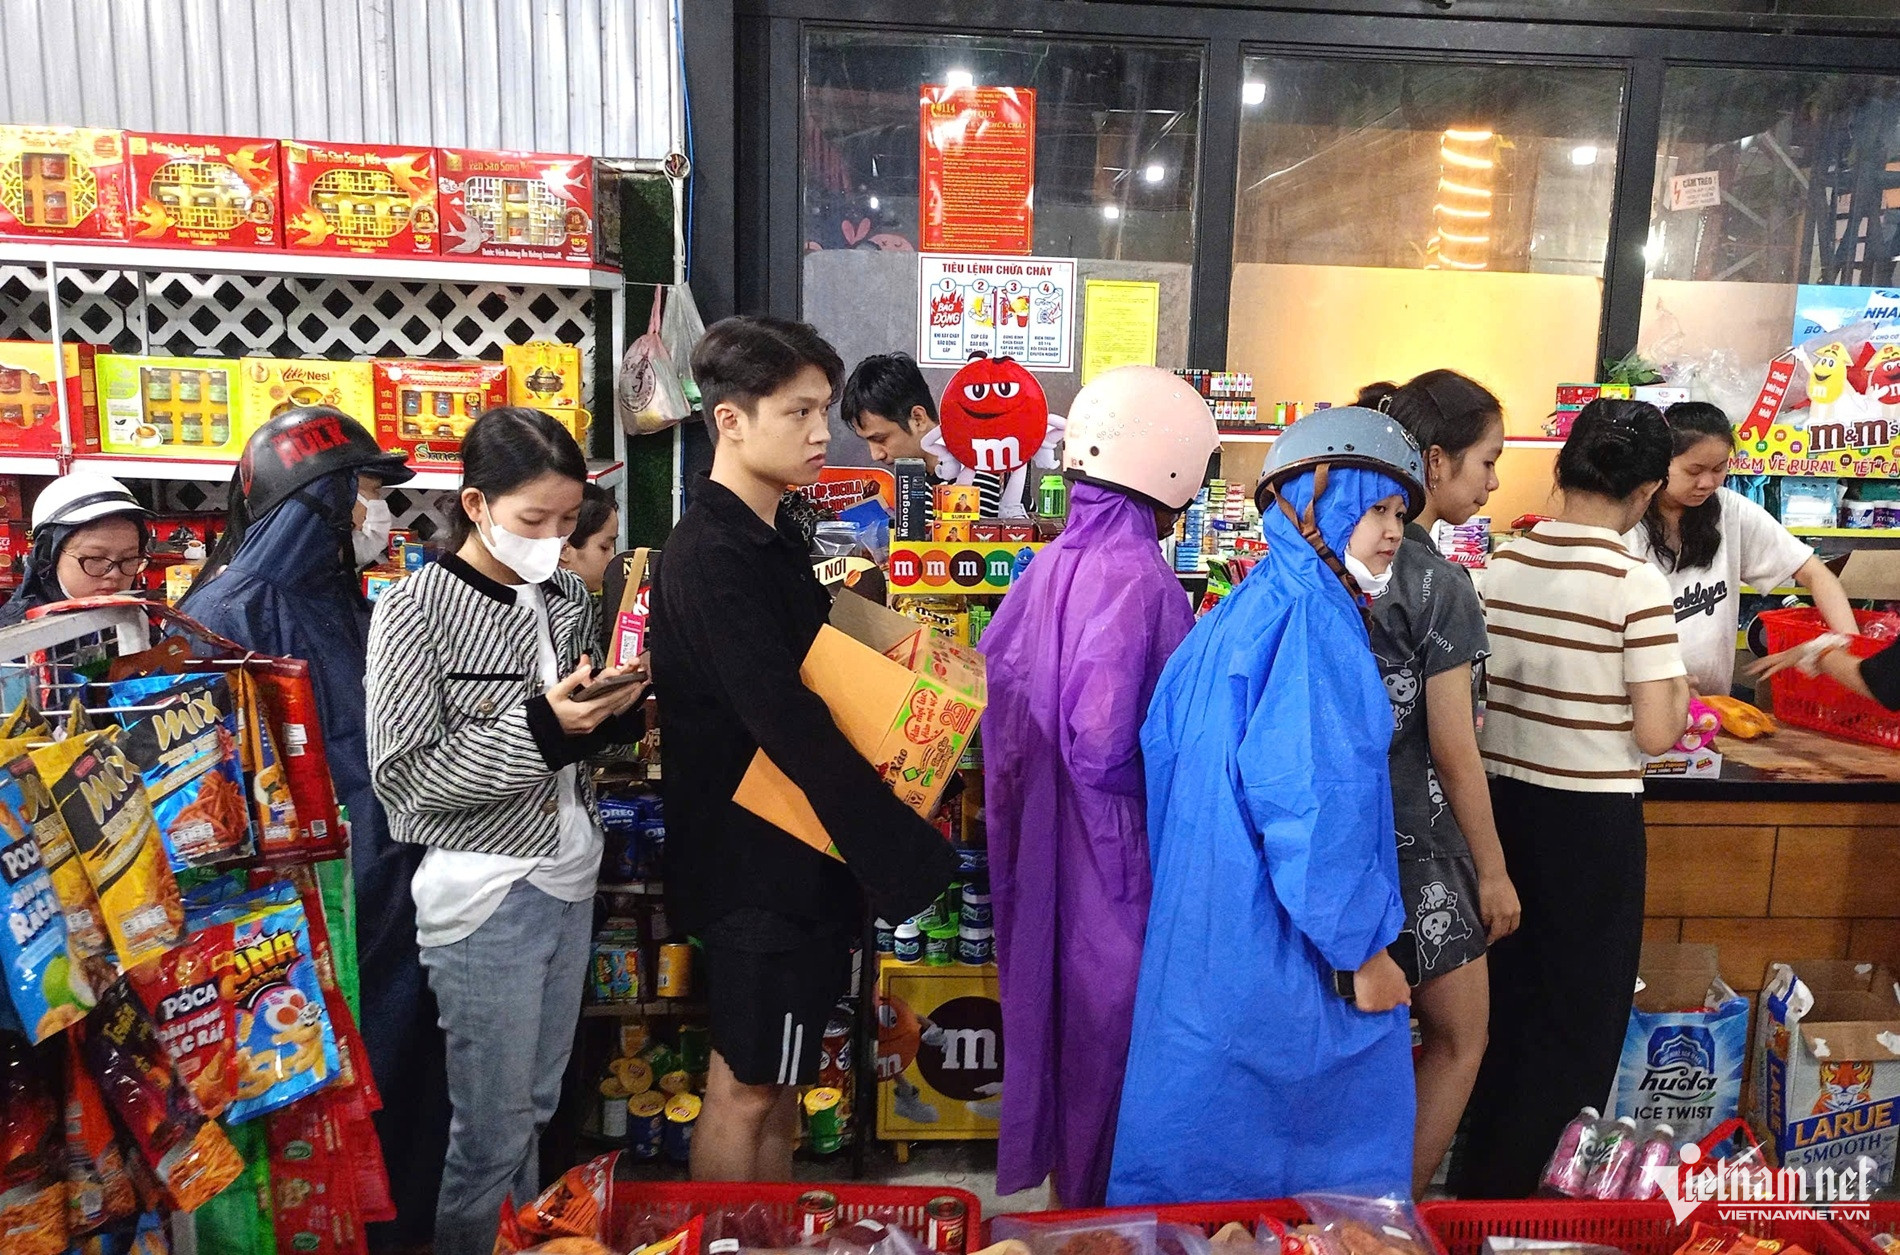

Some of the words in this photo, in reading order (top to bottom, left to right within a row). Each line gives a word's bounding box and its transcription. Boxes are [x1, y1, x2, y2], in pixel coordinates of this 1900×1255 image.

[967, 263, 993, 275] LỆNH
[996, 264, 1023, 275] CHỮA
[1026, 265, 1053, 276] CHÁY
[944, 281, 949, 289] 1
[977, 281, 984, 290] 2
[1010, 282, 1017, 291] 3
[1043, 284, 1050, 292] 4
[1864, 307, 1900, 319] NHA
[274, 420, 351, 469] HULK
[971, 436, 1023, 471] m
[1728, 457, 1764, 471] M&M
[1790, 459, 1837, 472] RURAL
[829, 480, 863, 496] SOCOLA
[901, 475, 911, 537] Monogatari
[894, 560, 914, 576] m
[926, 560, 946, 576] m
[958, 560, 978, 576] m
[990, 560, 1010, 576] m
[1673, 578, 1728, 615] oklyn
[1428, 627, 1454, 653] KURO
[153, 690, 223, 751] mix
[80, 743, 140, 825] mix
[600, 808, 635, 819] OREO
[645, 827, 665, 838] OR
[163, 982, 219, 1021] POCA
[941, 1027, 998, 1070] m
[1639, 1069, 1718, 1092] huda
[1634, 1106, 1665, 1120] ICE
[1668, 1105, 1715, 1119] TWIST
[1794, 1100, 1894, 1148] LARUE
[1803, 1137, 1882, 1165] SMOOTH
